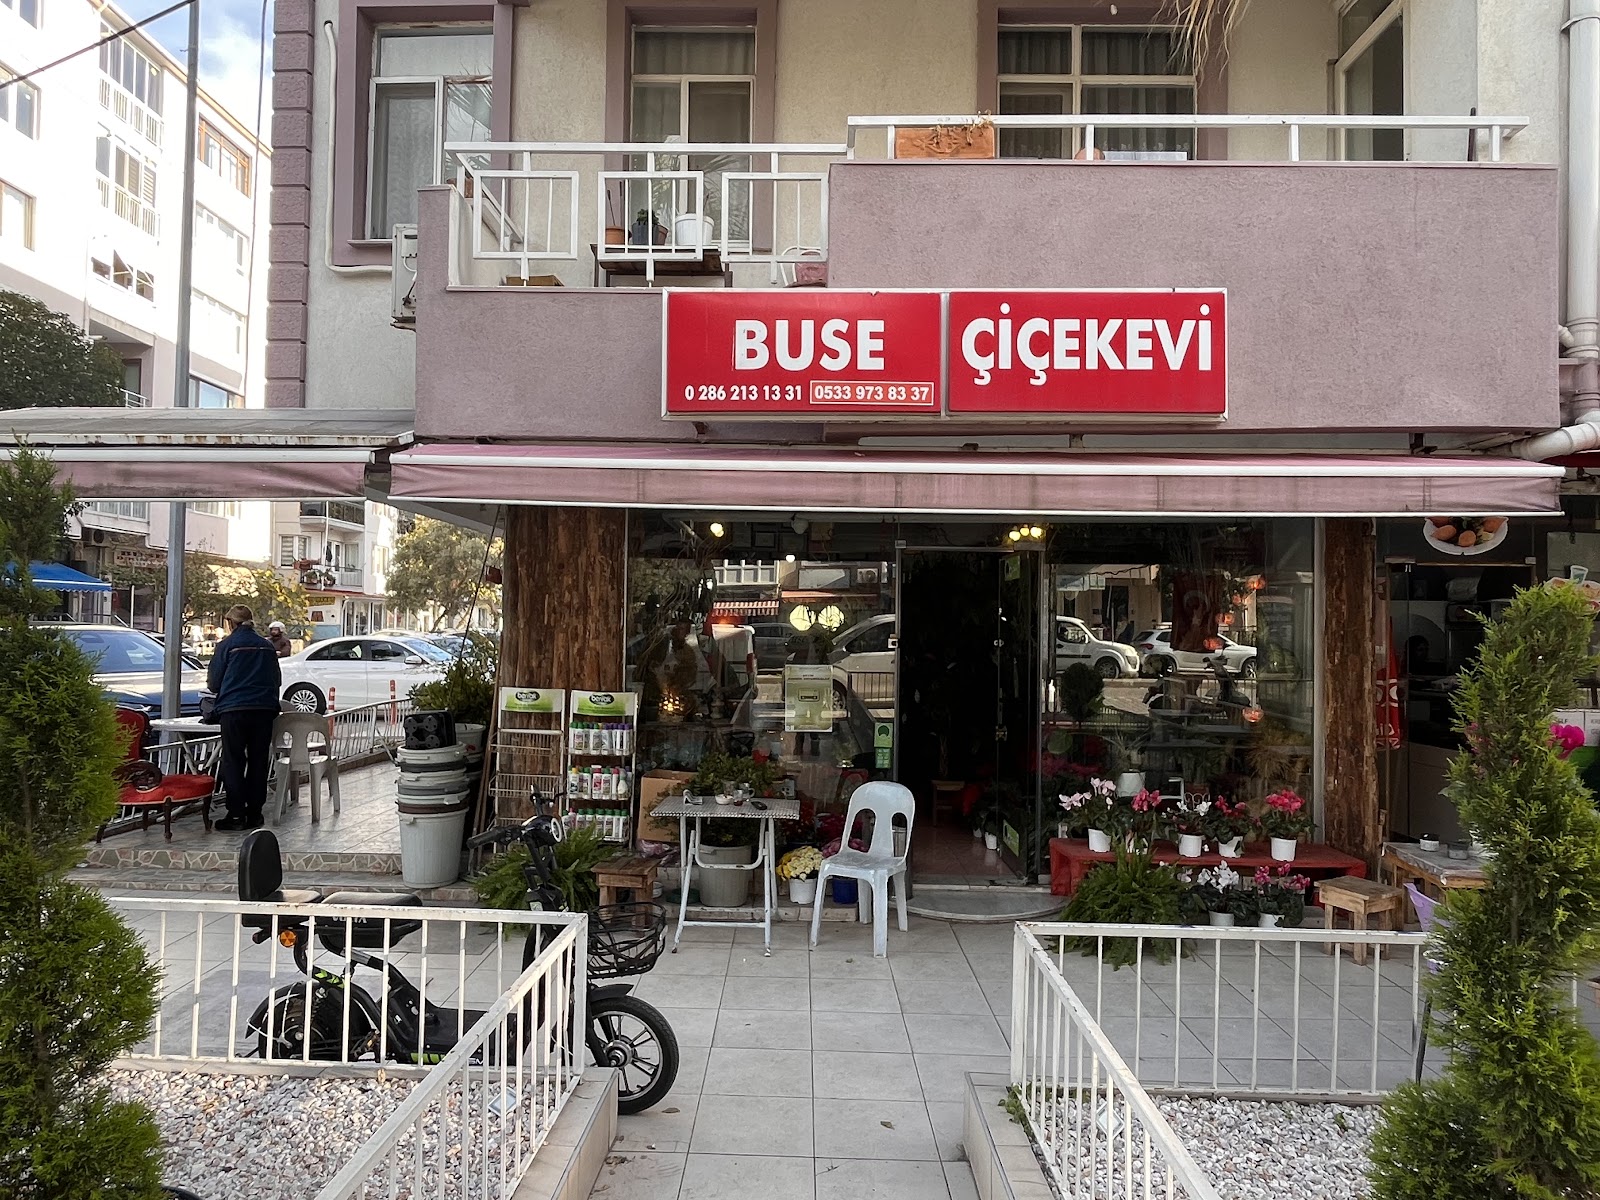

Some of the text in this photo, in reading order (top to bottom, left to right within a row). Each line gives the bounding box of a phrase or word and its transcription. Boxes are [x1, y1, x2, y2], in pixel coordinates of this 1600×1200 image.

[735, 319, 885, 371] BUSE
[962, 303, 1212, 386] ÇİÇEKEVİ
[684, 385, 803, 401] 0 286 213 13 31
[814, 385, 929, 401] 0533 973 83 37
